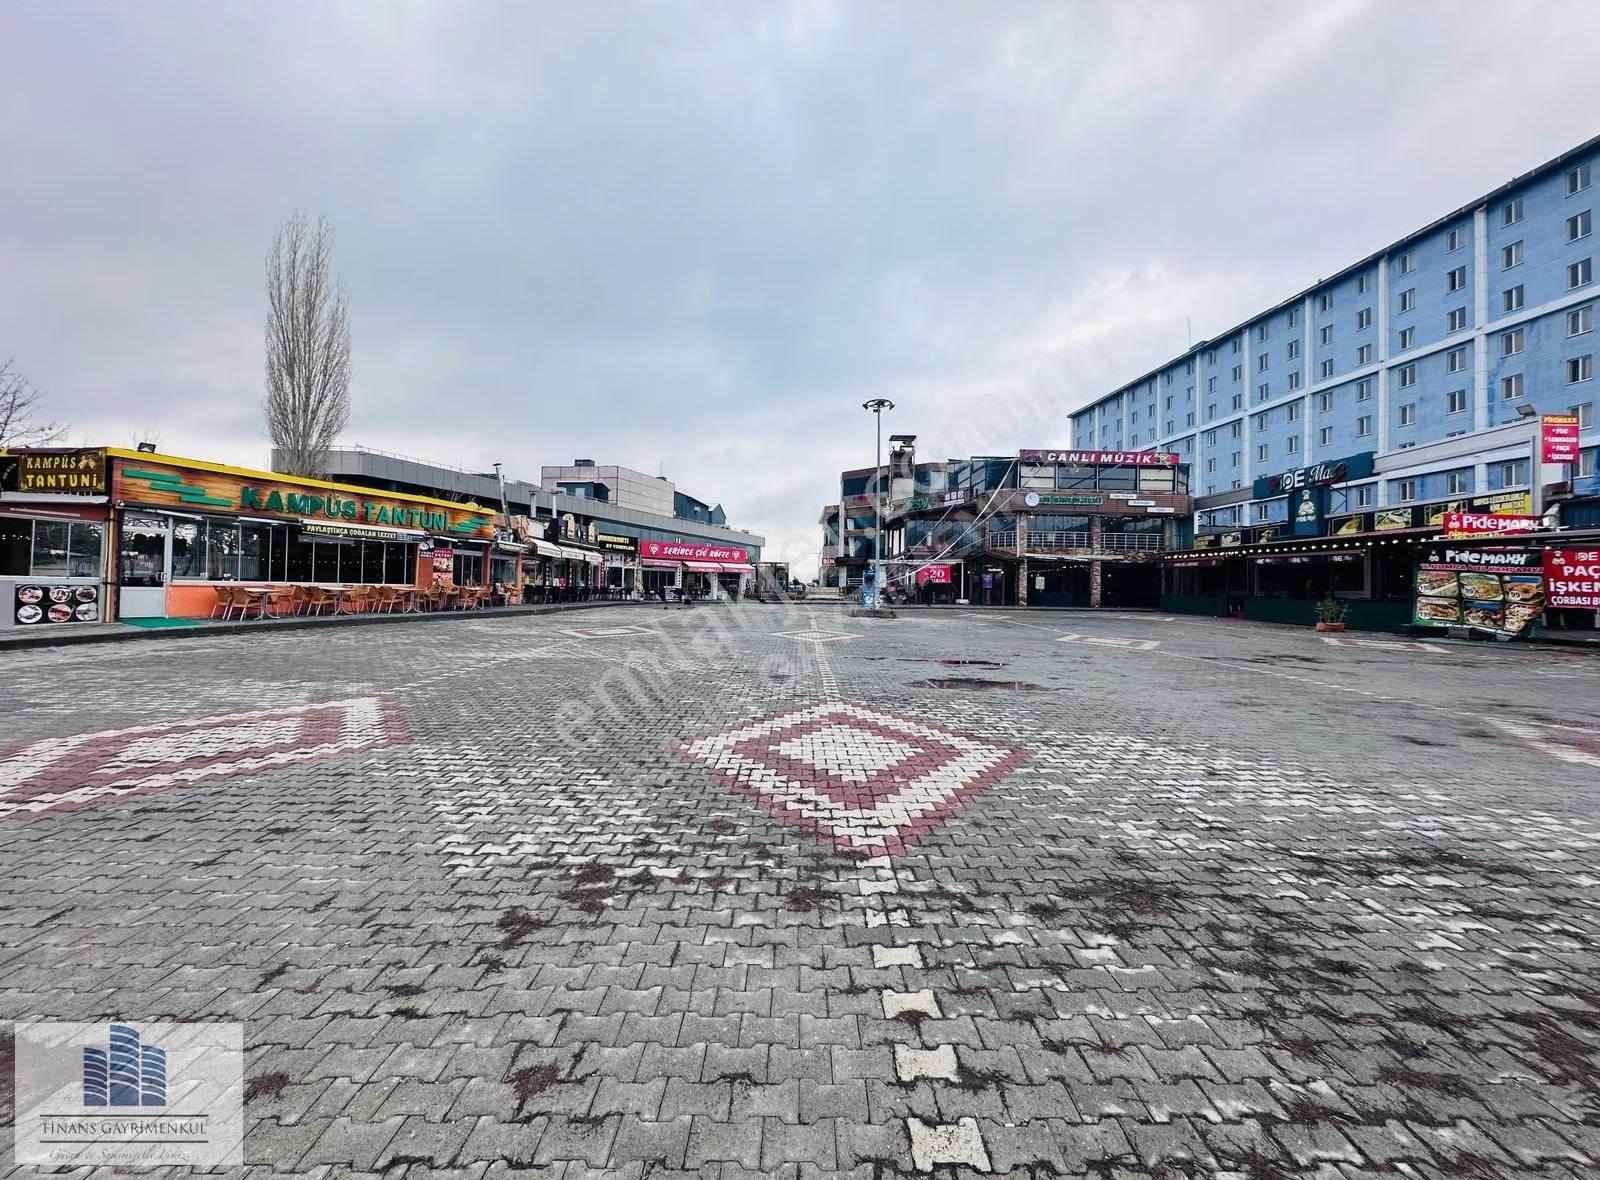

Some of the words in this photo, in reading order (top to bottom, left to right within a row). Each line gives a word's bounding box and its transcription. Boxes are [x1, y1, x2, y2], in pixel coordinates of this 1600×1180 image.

[26, 454, 76, 469] KAMPÜS
[1047, 452, 1095, 462] CANLI
[1100, 451, 1152, 463] MÜZİK
[239, 485, 357, 520] KAMPÜS
[363, 502, 450, 531] TANTUNİ
[377, 531, 397, 539] LEZZET
[663, 546, 693, 556] SERİNCE
[695, 547, 707, 557] ÇİĞ
[709, 549, 730, 559] KÖFTE
[1445, 549, 1528, 565] PideMAXX
[1551, 596, 1591, 606] ÇORBASI
